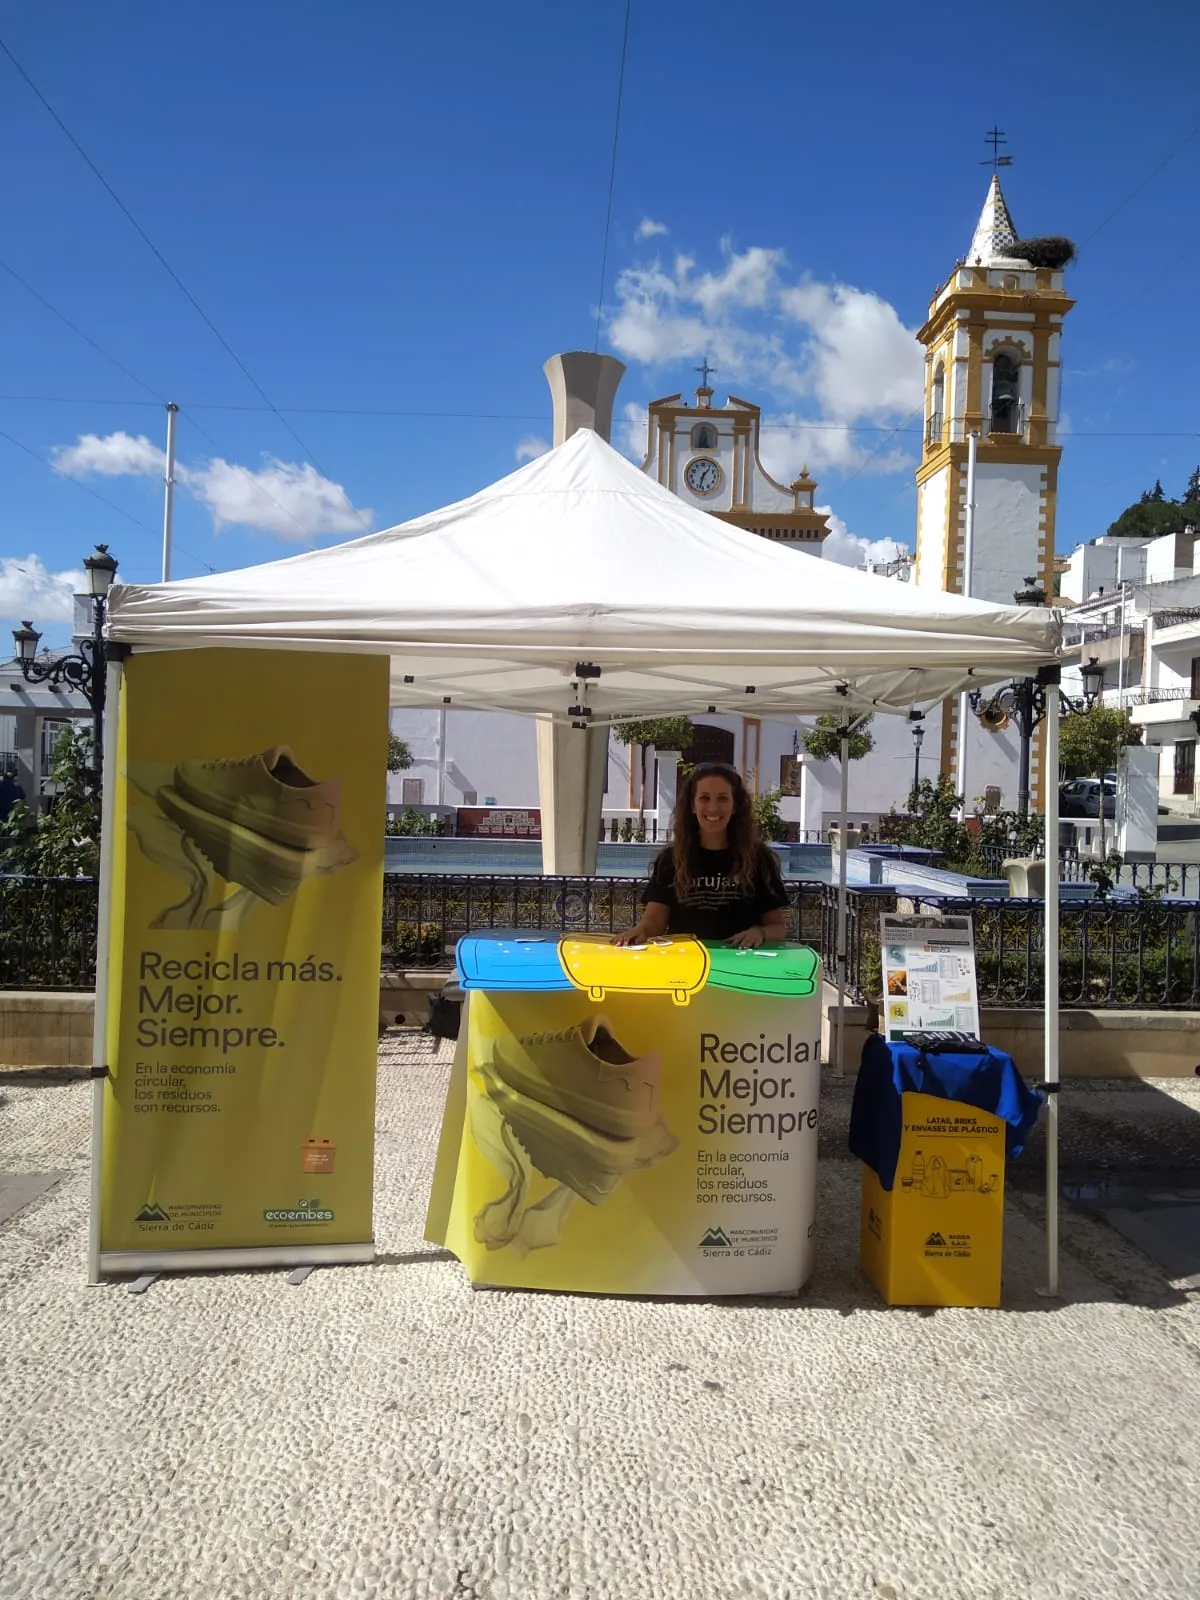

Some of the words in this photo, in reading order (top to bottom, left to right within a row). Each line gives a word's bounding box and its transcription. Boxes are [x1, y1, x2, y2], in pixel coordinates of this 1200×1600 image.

[139, 951, 260, 982] Recicla
[266, 954, 343, 983] más.
[138, 984, 243, 1021] Mejor.
[135, 1018, 286, 1054] Siempre.
[135, 1062, 153, 1074] En
[156, 1062, 168, 1074] la
[170, 1062, 236, 1074] economía
[134, 1075, 187, 1089] circular,
[699, 1068, 796, 1107] Mejor.
[134, 1089, 154, 1101] los
[157, 1089, 212, 1101] residuos
[134, 1103, 159, 1114] son
[161, 1101, 222, 1113] recursos.
[697, 1103, 819, 1141] Siempre
[926, 1117, 952, 1125] LATAS,
[904, 1124, 910, 1132] Y
[948, 1125, 960, 1133] DE
[961, 1125, 999, 1134] PLÁSTICO
[697, 1150, 713, 1162] En
[716, 1150, 727, 1162] la
[729, 1149, 790, 1162] economía
[696, 1163, 746, 1177] circular,
[696, 1177, 714, 1190] los
[717, 1177, 769, 1190] residuos
[696, 1193, 718, 1204] son
[721, 1192, 777, 1203] recursos.
[265, 1209, 333, 1220] ecoembes
[138, 1223, 169, 1232] Sierra
[172, 1223, 185, 1231] de
[188, 1221, 215, 1230] Cádiz
[703, 1249, 731, 1257] Sierra
[733, 1249, 745, 1257] de
[748, 1247, 772, 1256] Cádiz
